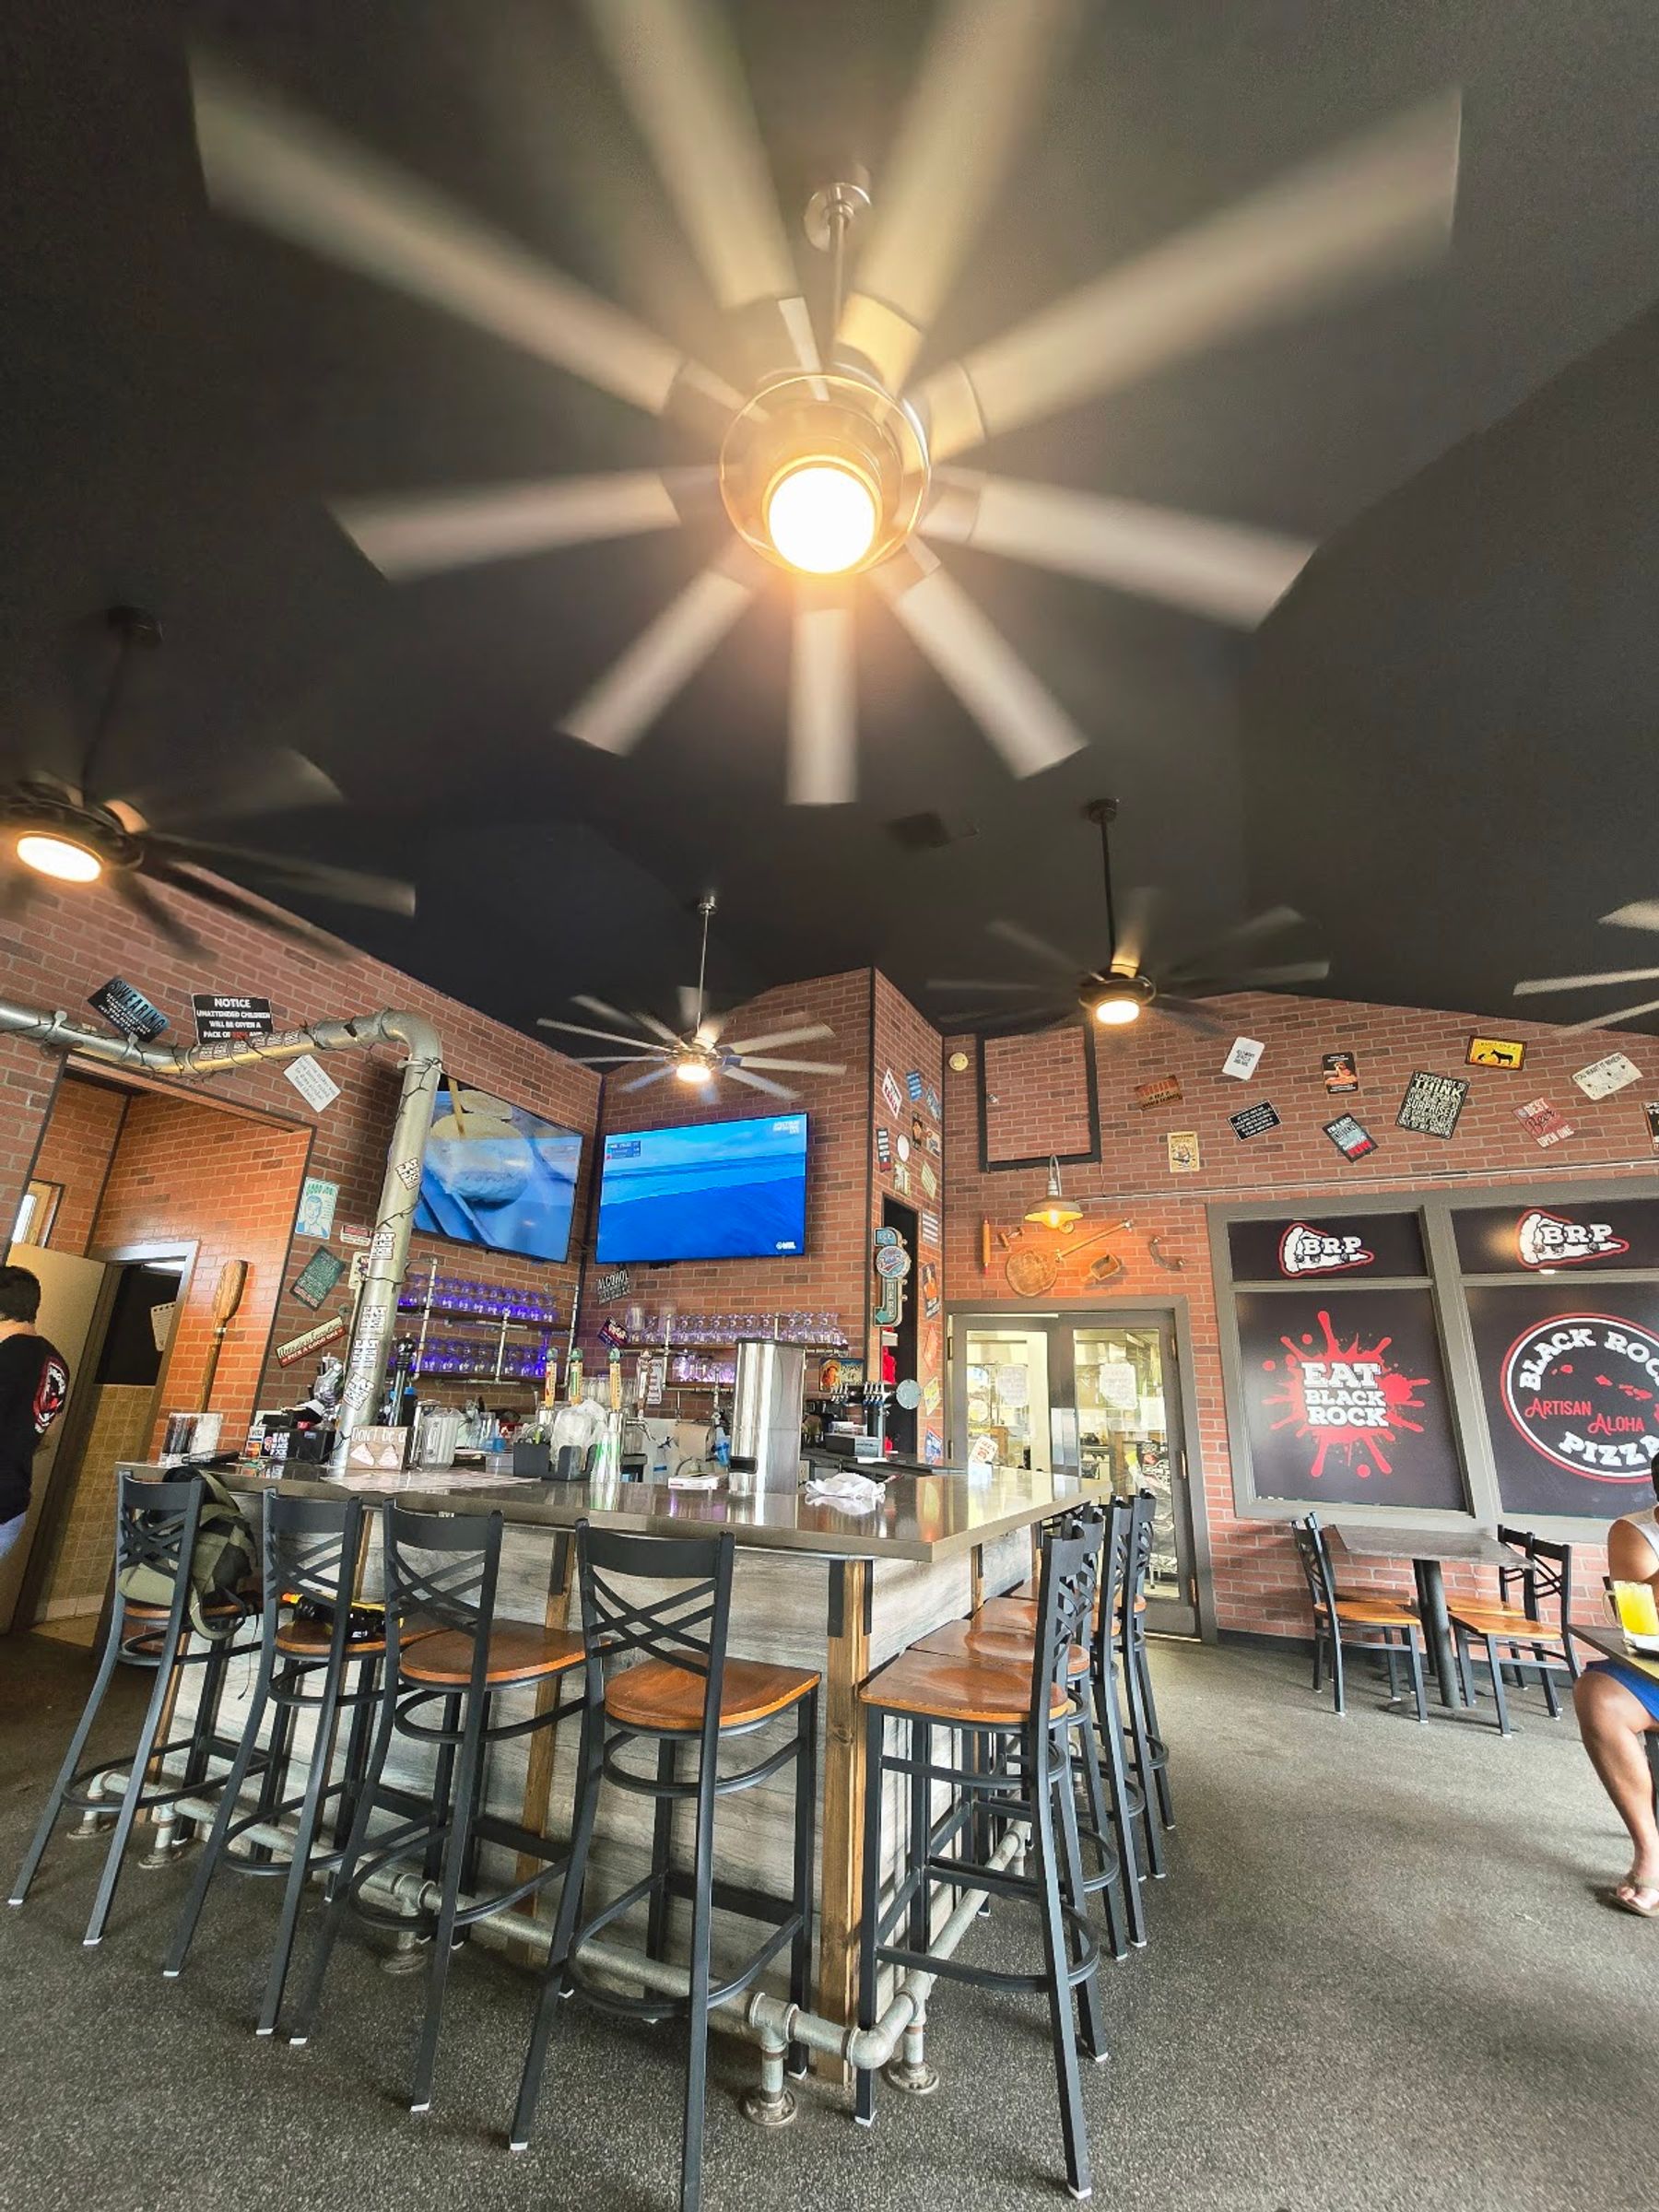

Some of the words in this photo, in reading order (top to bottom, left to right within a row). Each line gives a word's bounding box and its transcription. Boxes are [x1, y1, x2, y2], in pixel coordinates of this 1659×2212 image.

[109, 980, 166, 1031] SWEARING
[214, 997, 251, 1008] NOTICE
[196, 1009, 240, 1018] UNATTENDED
[1412, 1077, 1463, 1099] THINK
[1406, 1098, 1456, 1118] SURPRISED
[1524, 1097, 1550, 1117] BEST
[1536, 1133, 1559, 1148] OPEN
[1559, 1124, 1575, 1139] ONE
[597, 1269, 629, 1290] ALCOHOL
[307, 1335, 326, 1349] GOOD
[1520, 1328, 1596, 1392] BLACK
[1604, 1331, 1659, 1386] ROC
[1301, 1362, 1382, 1388] EAT
[1304, 1389, 1386, 1406] BLACK
[1307, 1406, 1389, 1427] ROCK
[1524, 1398, 1592, 1419] ARTISAN
[1587, 1413, 1645, 1436] ALOHA
